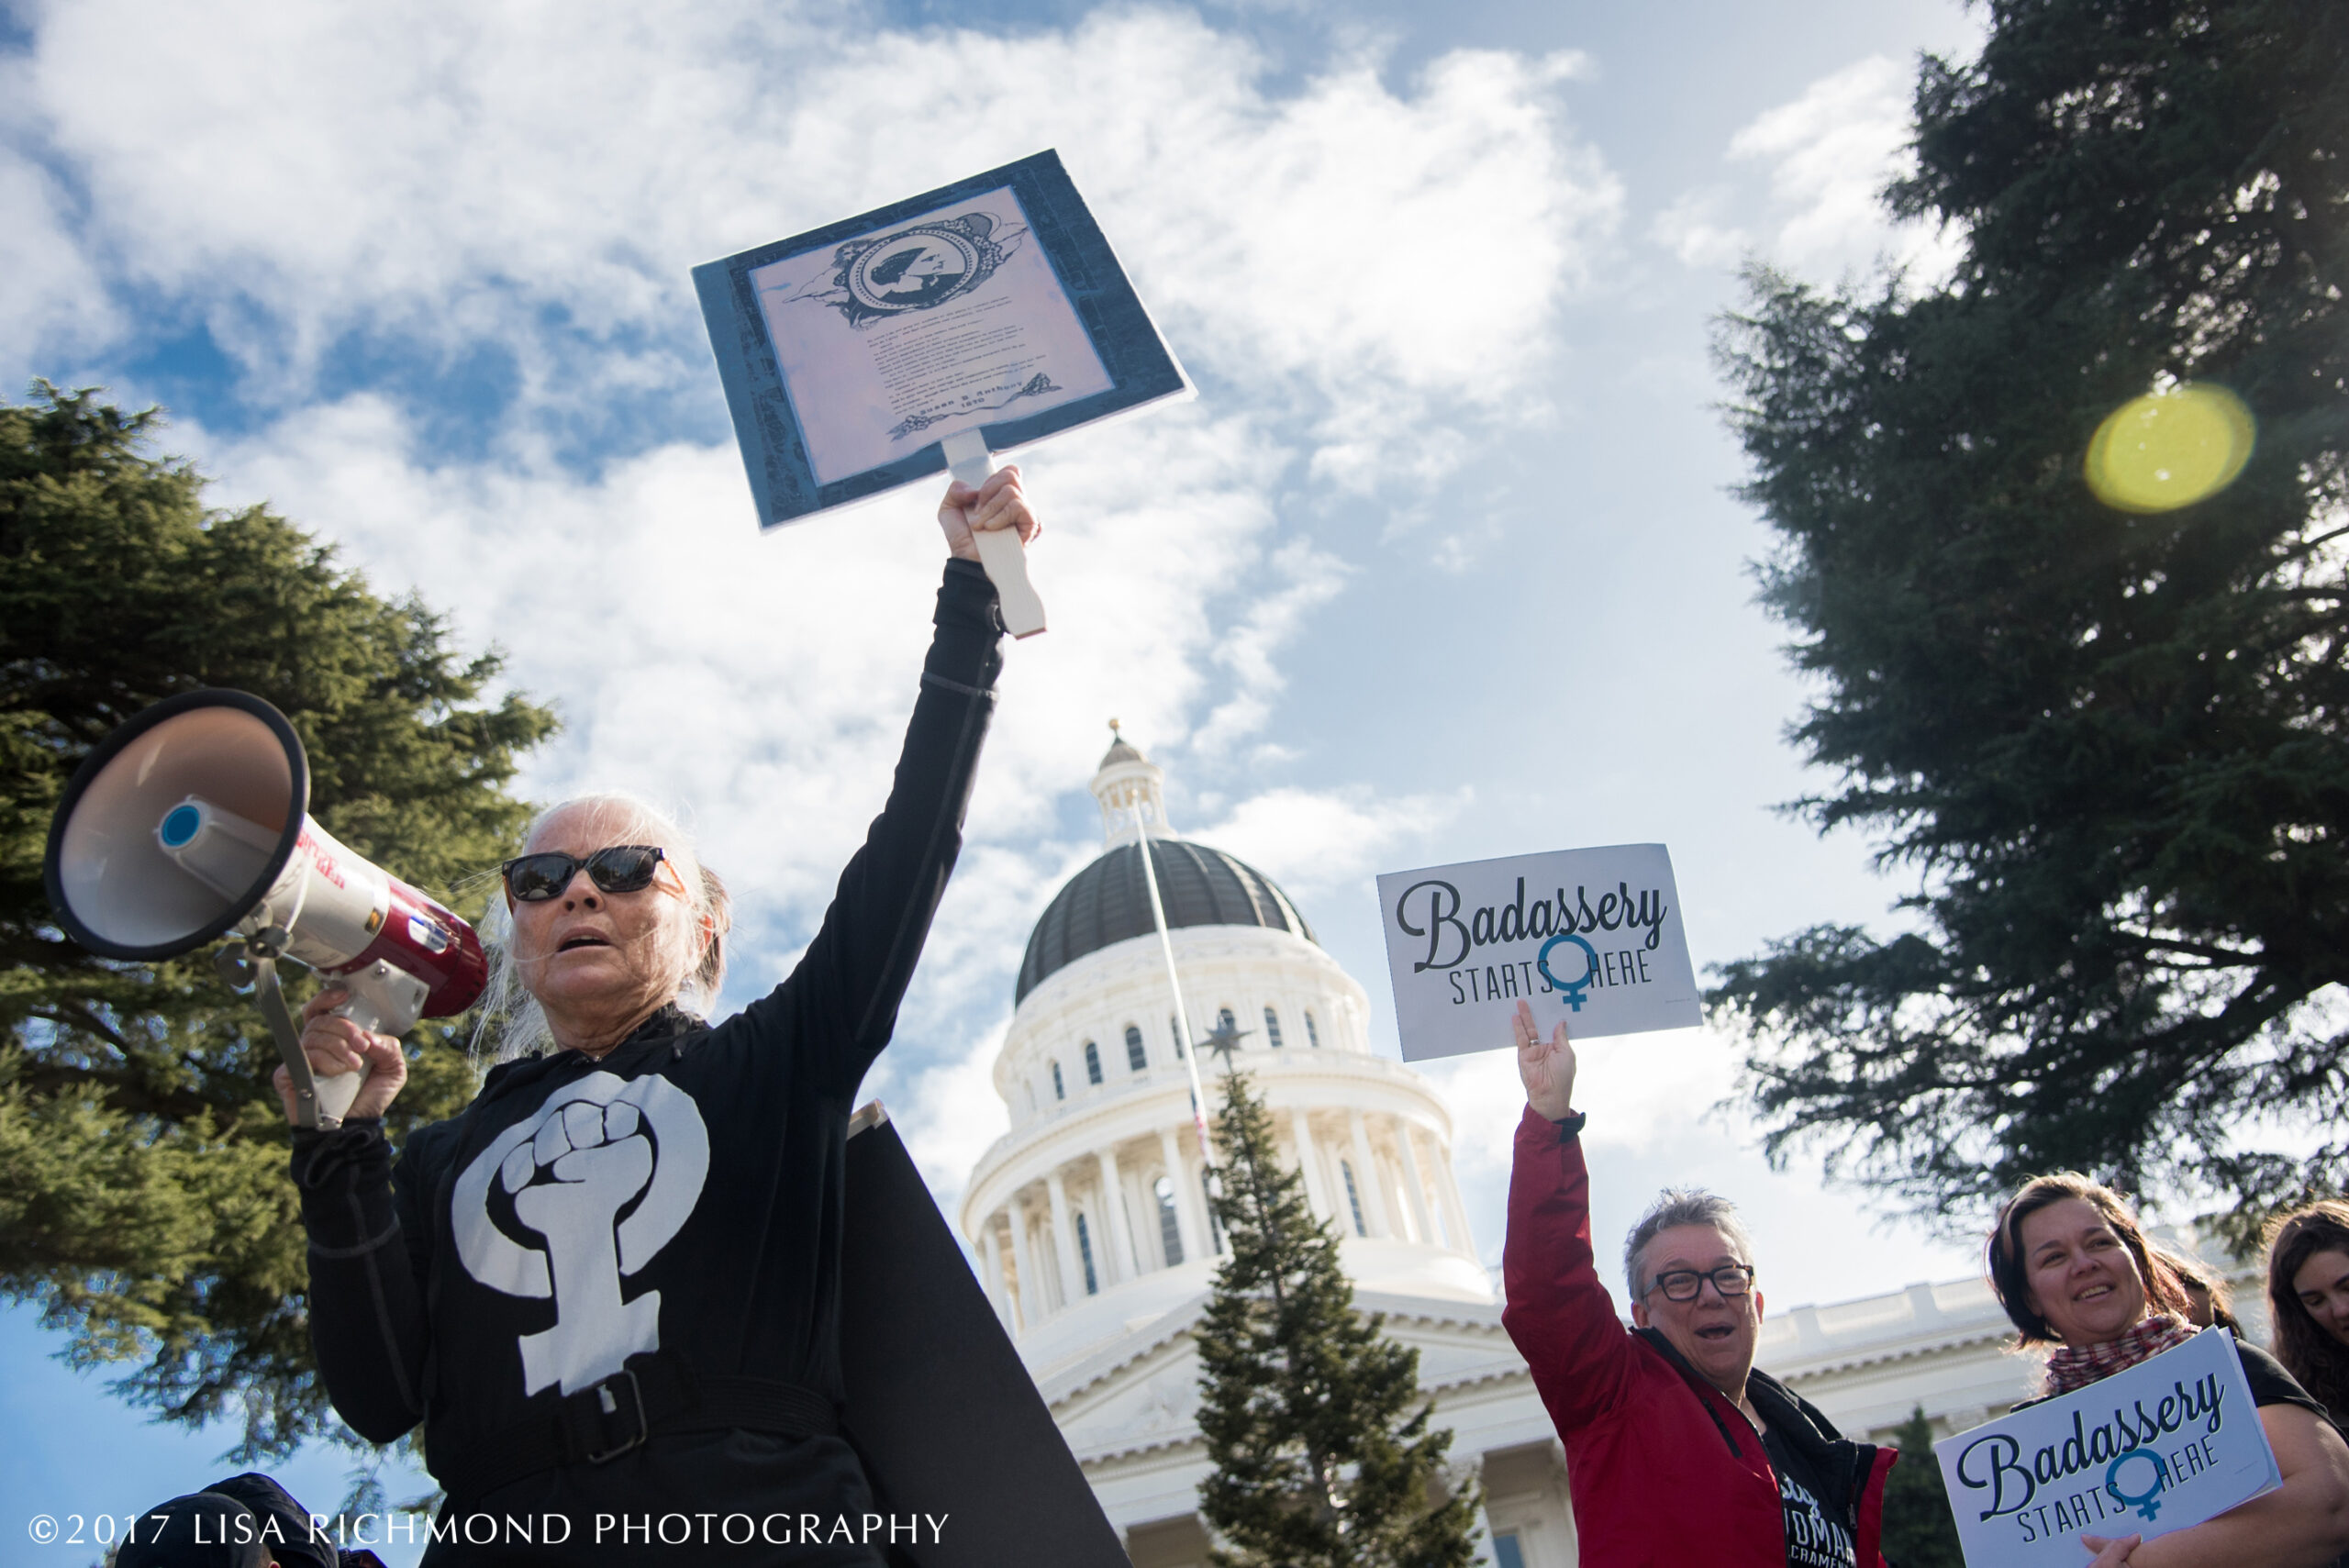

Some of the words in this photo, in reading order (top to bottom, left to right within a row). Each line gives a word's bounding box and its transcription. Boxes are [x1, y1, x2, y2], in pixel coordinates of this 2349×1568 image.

[1396, 876, 1668, 974] Badassery
[1449, 959, 1553, 1005] STARTS
[1586, 949, 1653, 989] HERE
[1956, 1373, 2225, 1523] Badassery
[2017, 1480, 2127, 1542] STARTS
[2153, 1433, 2220, 1494] HERE
